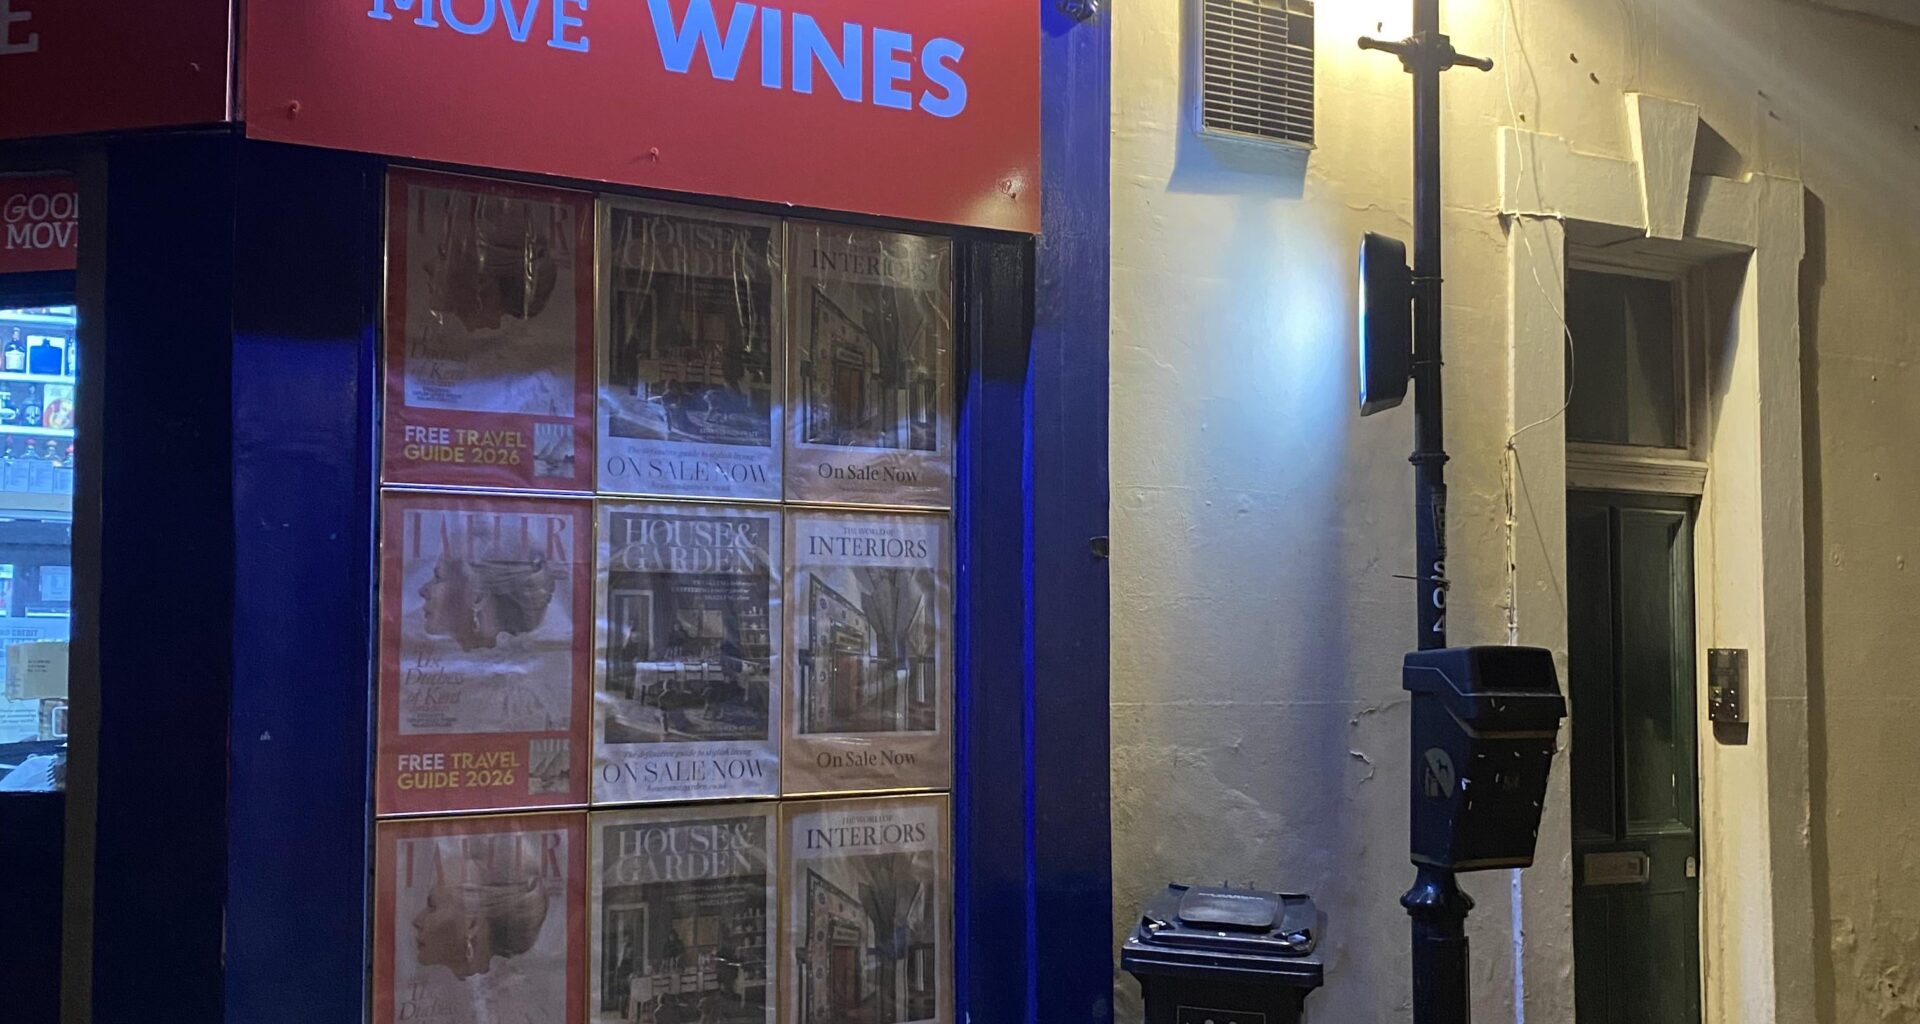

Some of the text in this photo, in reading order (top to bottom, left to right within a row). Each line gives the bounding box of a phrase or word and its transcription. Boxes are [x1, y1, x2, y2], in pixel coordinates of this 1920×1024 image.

[646, 0, 968, 118] WINES
[5, 221, 78, 249] MOV
[404, 426, 450, 444] FREE
[455, 429, 527, 448] TRAVEL
[403, 444, 521, 465] GUIDE 2026
[606, 455, 768, 484] ON SALE NOW
[818, 462, 919, 483] On Sale Now
[808, 535, 927, 558] INTERIORS
[622, 544, 756, 575] GARDEN
[397, 751, 521, 771] FREE TRAVEL
[816, 749, 918, 768] On Sale Now
[396, 769, 515, 790] GUIDE 2026
[602, 758, 764, 784] ON SALE NOW
[806, 822, 926, 850] INTERIORS
[615, 849, 752, 884] GARDEN
